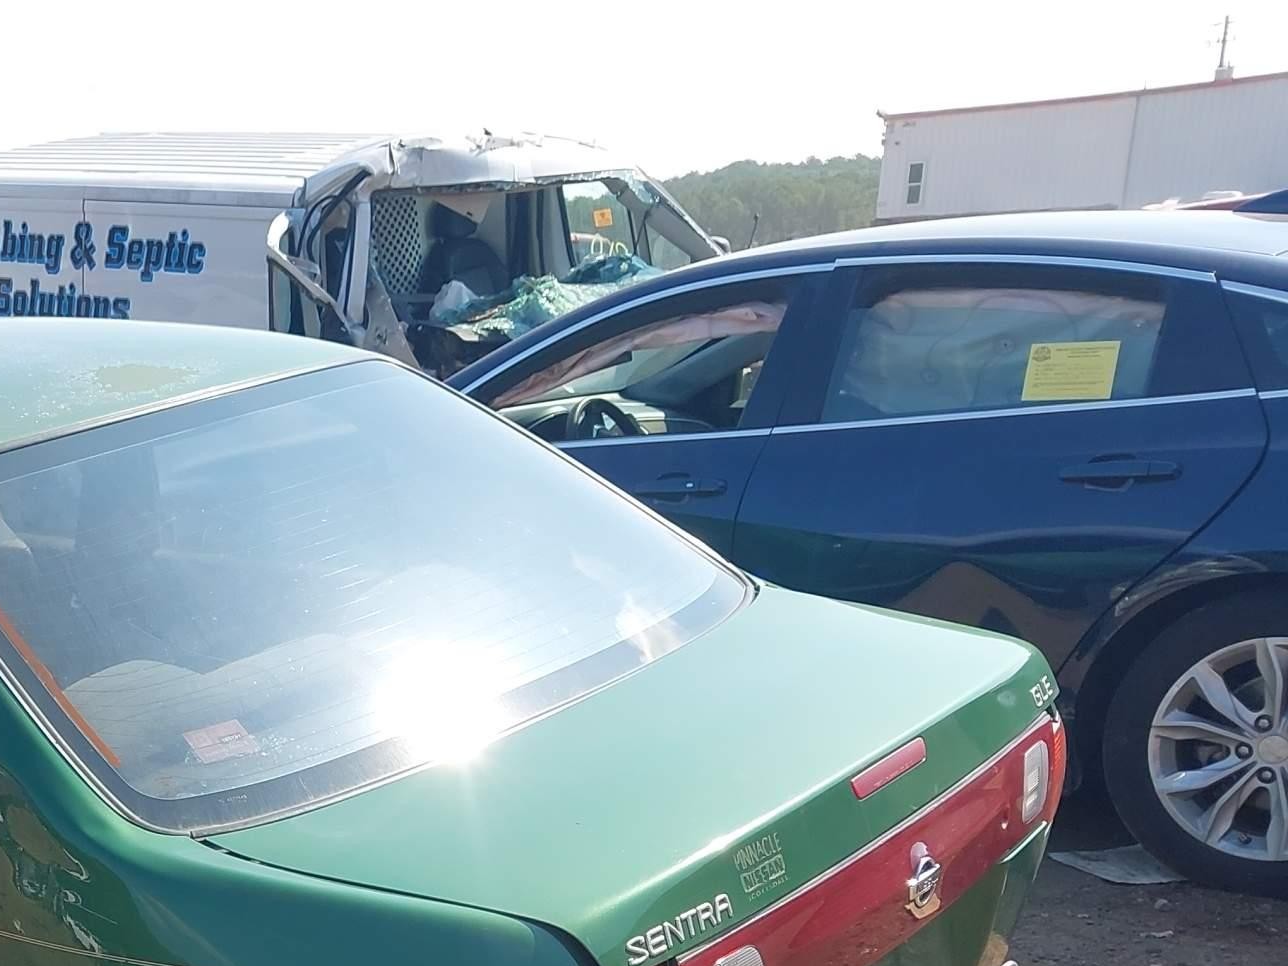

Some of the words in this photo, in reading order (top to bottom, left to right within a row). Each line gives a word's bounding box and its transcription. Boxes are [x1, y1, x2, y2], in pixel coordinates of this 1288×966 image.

[69, 221, 97, 272] &
[104, 225, 206, 282] Septic
[733, 831, 782, 871] PINNACLE
